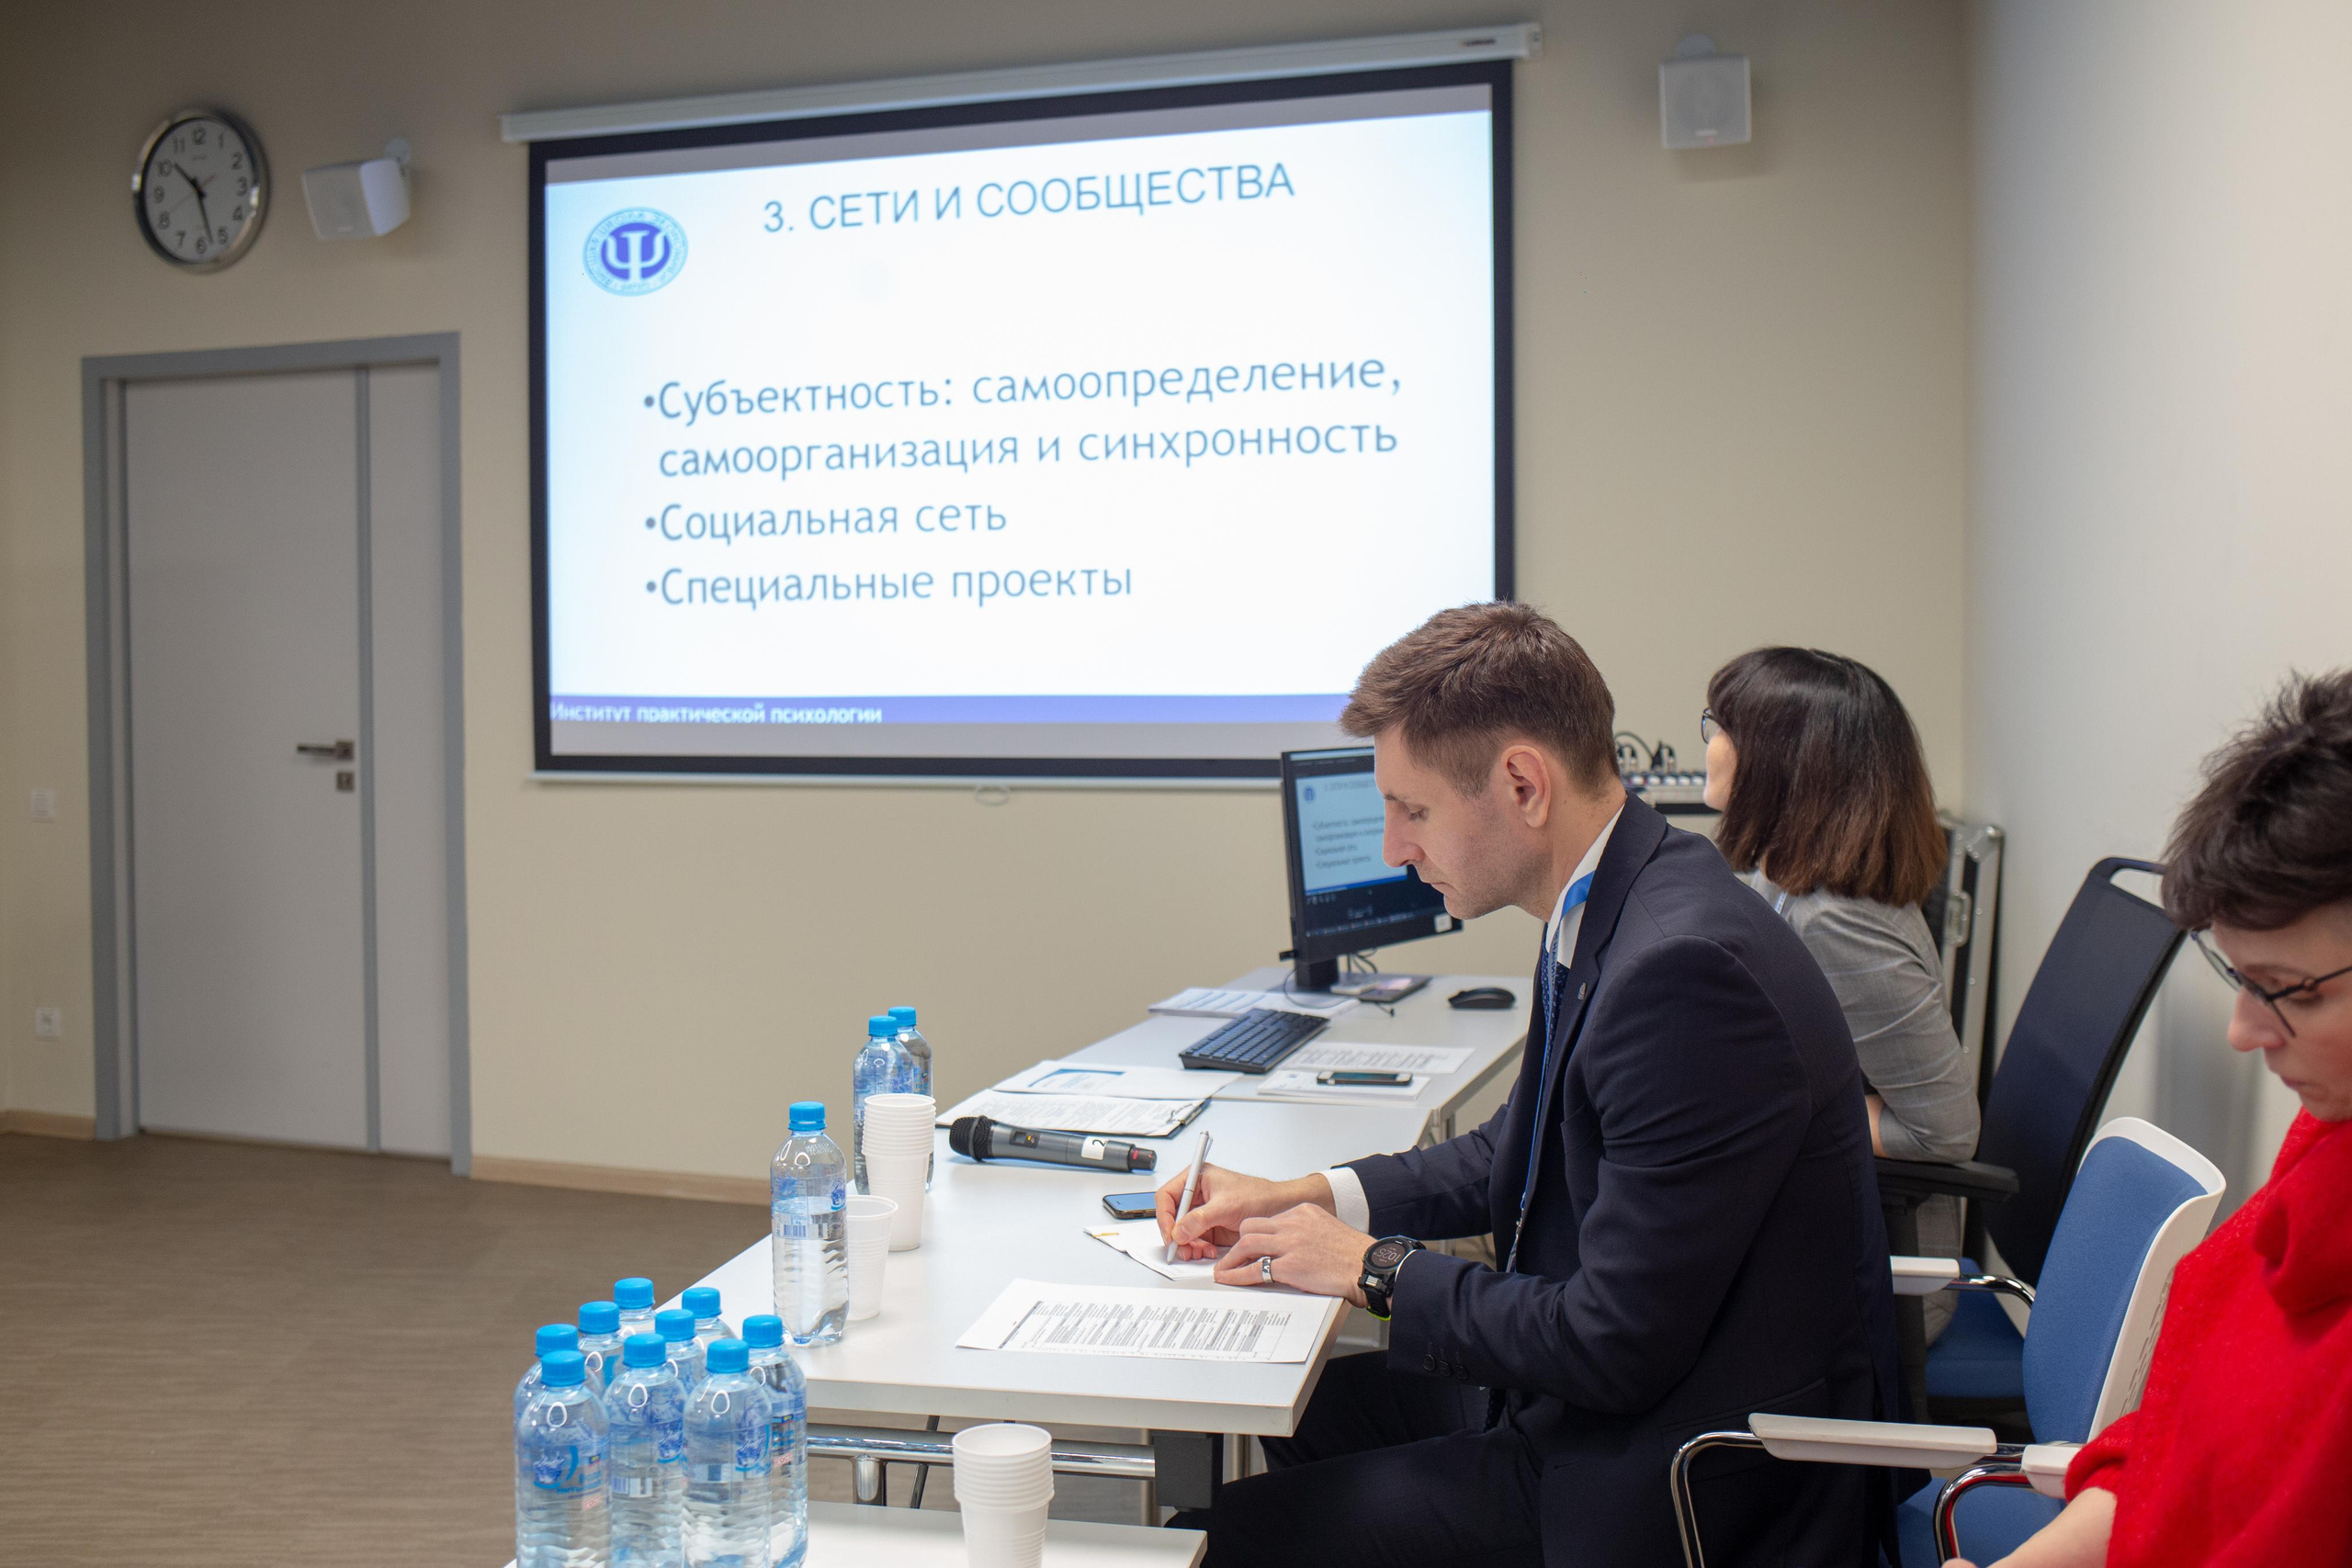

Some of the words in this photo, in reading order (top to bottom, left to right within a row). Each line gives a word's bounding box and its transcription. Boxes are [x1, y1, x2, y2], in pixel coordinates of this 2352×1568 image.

[763, 200, 796, 232] 3.
[809, 189, 919, 230] СЕТИ
[935, 186, 961, 220] И
[977, 163, 1295, 217] СООБЩЕСТВА
[659, 379, 952, 427] Субъектность:
[973, 359, 1401, 407] самоопределение,
[659, 436, 1019, 481] самоорганизация
[1037, 436, 1060, 462] и
[1079, 424, 1397, 468] синхронность
[661, 503, 898, 547] Социальная
[916, 502, 1007, 533] сеть
[661, 568, 934, 610] Специальные
[952, 568, 1132, 608] проекты
[551, 704, 631, 722] Институт
[637, 702, 765, 724] практической
[771, 705, 883, 724] психологии
